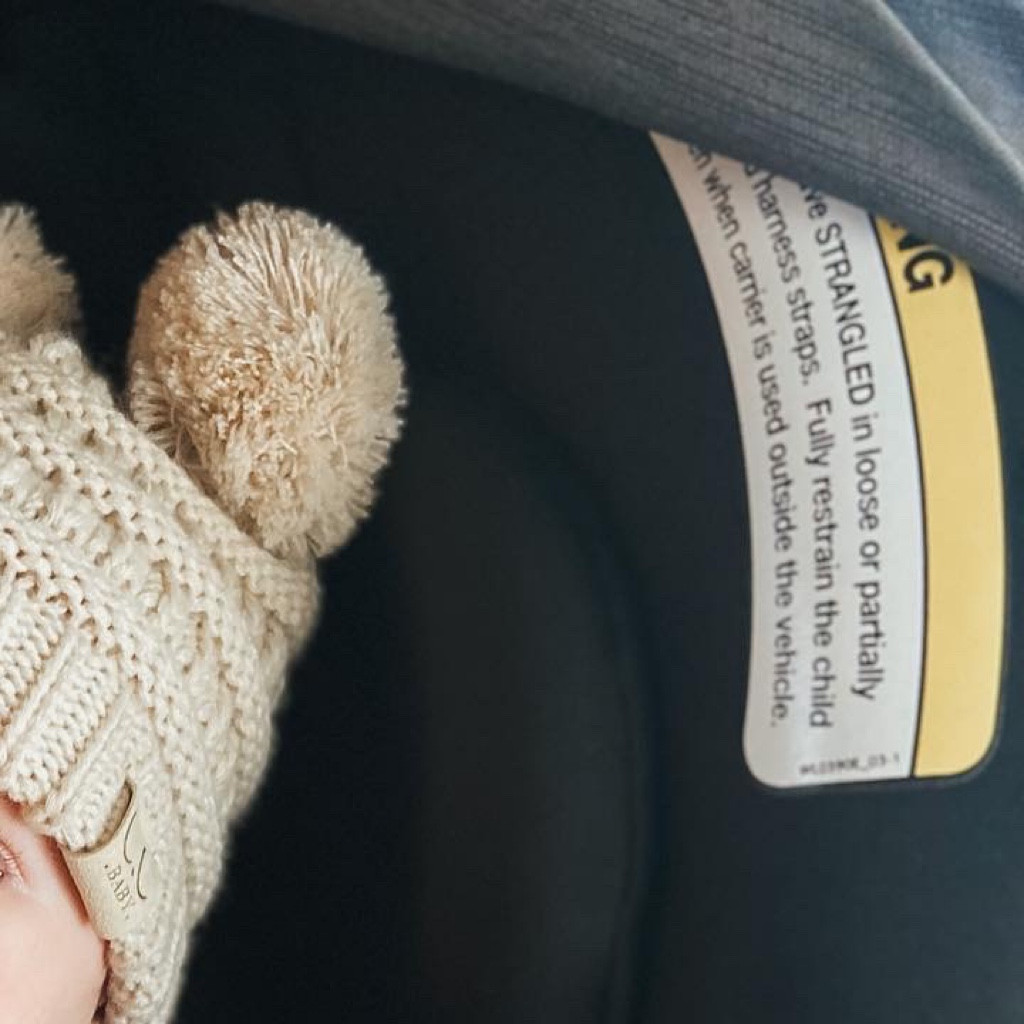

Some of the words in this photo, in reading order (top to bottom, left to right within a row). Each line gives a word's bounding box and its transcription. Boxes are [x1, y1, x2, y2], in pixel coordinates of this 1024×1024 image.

[702, 170, 740, 240] when
[751, 172, 801, 284] harness
[729, 241, 768, 329] carrier
[814, 222, 876, 406] STRANGLED
[752, 331, 777, 360] is
[786, 288, 820, 387] straps.
[757, 364, 789, 435] used
[805, 398, 837, 467] Fully
[850, 412, 879, 441] in
[768, 443, 797, 552] outside
[855, 448, 882, 530] loose
[812, 477, 842, 592] restrain
[860, 541, 882, 572] or
[774, 560, 800, 609] the
[814, 600, 841, 648] the
[850, 581, 887, 701] partially
[809, 656, 837, 728] child
